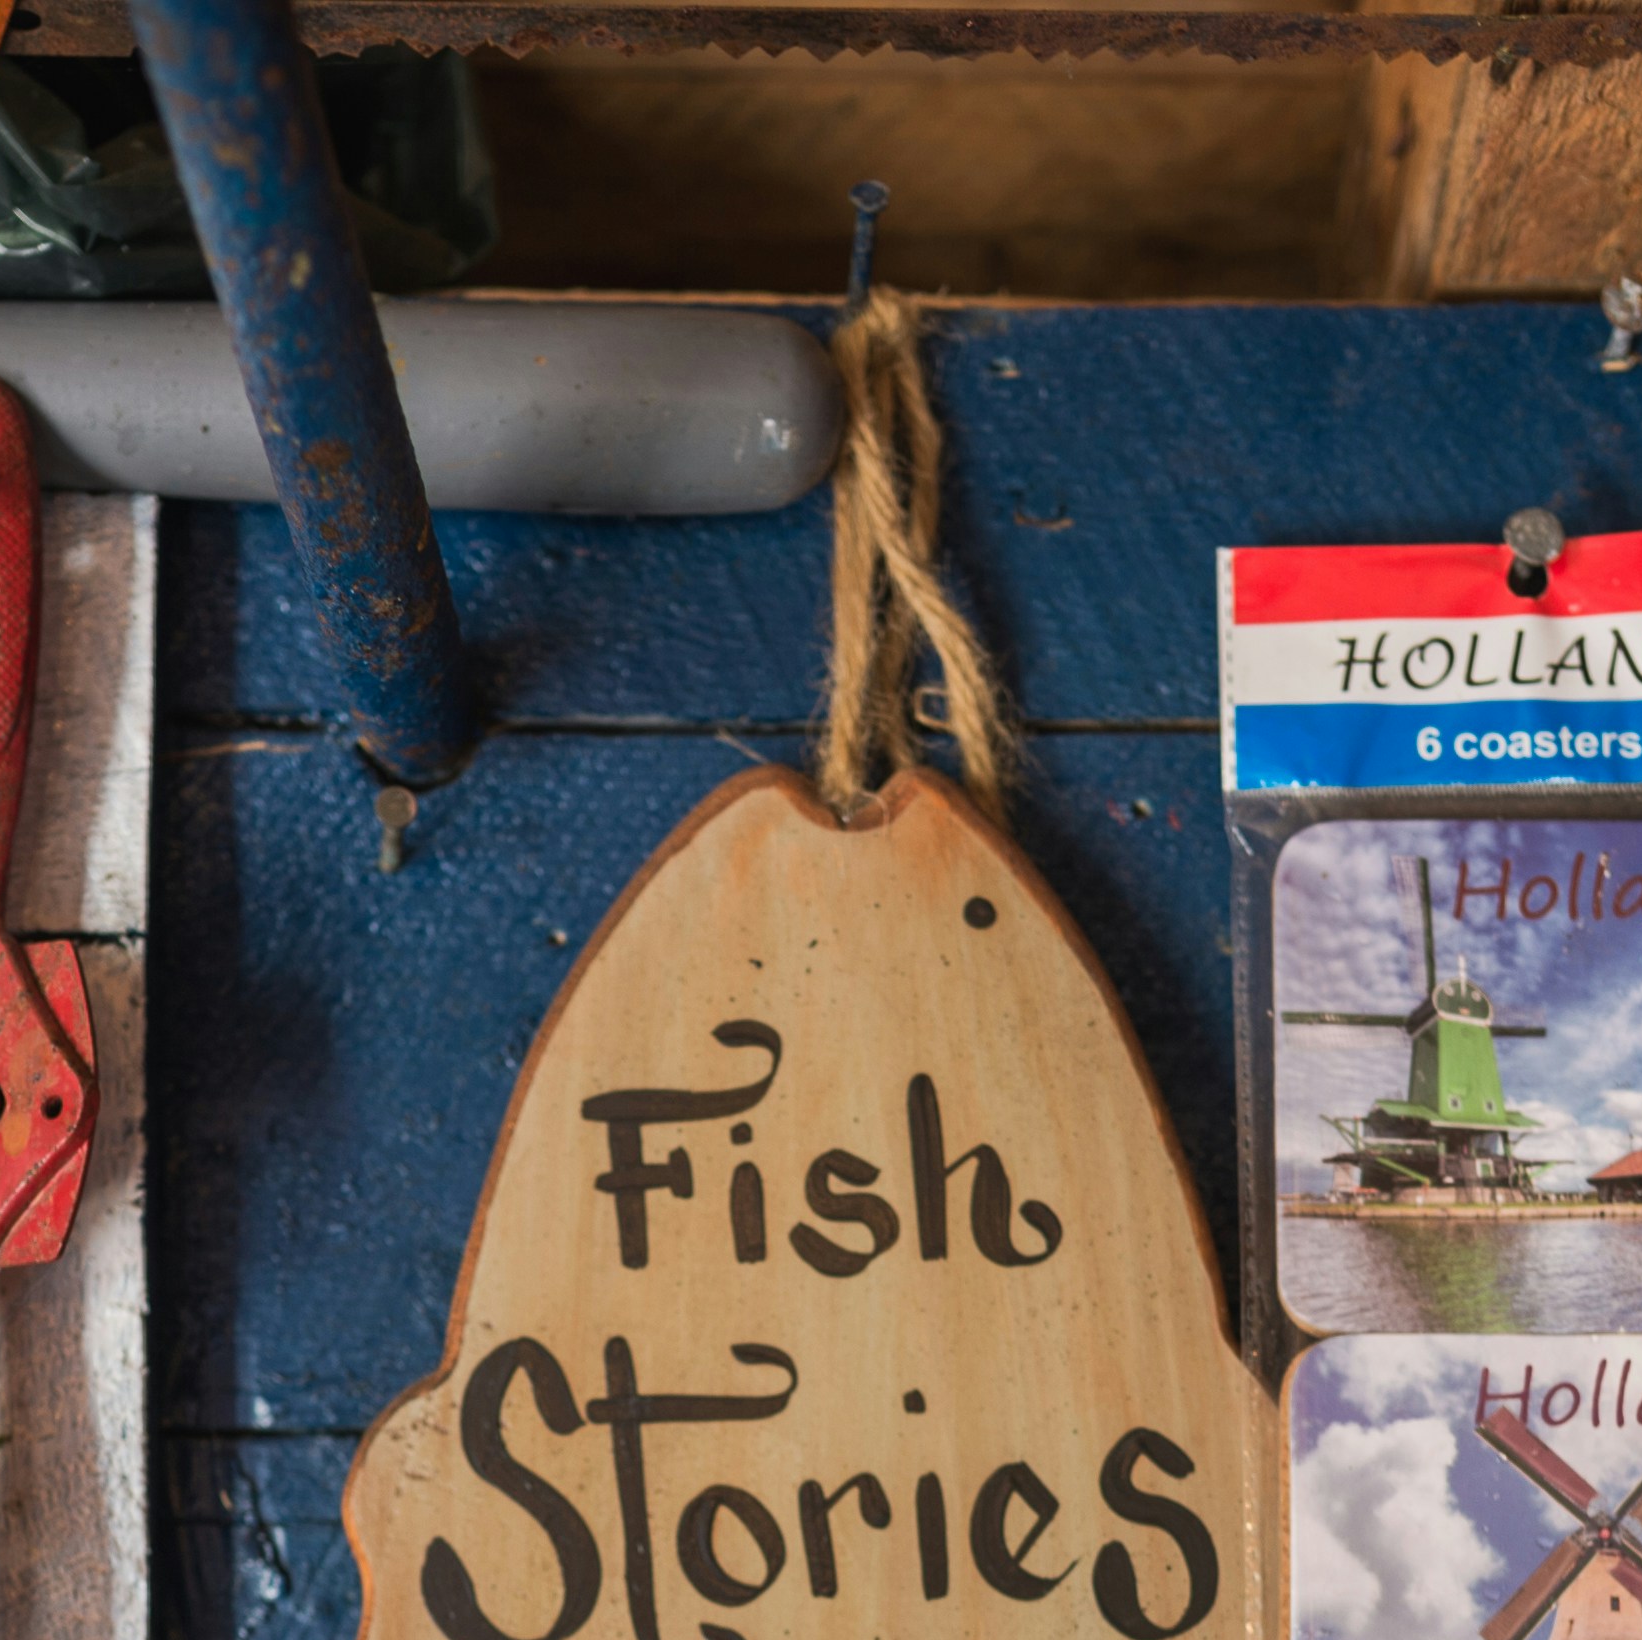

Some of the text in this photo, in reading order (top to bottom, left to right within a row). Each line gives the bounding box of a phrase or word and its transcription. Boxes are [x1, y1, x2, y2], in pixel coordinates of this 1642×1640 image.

[1416, 725, 1642, 761] 6 coasters
[581, 1019, 1063, 1279] Fish
